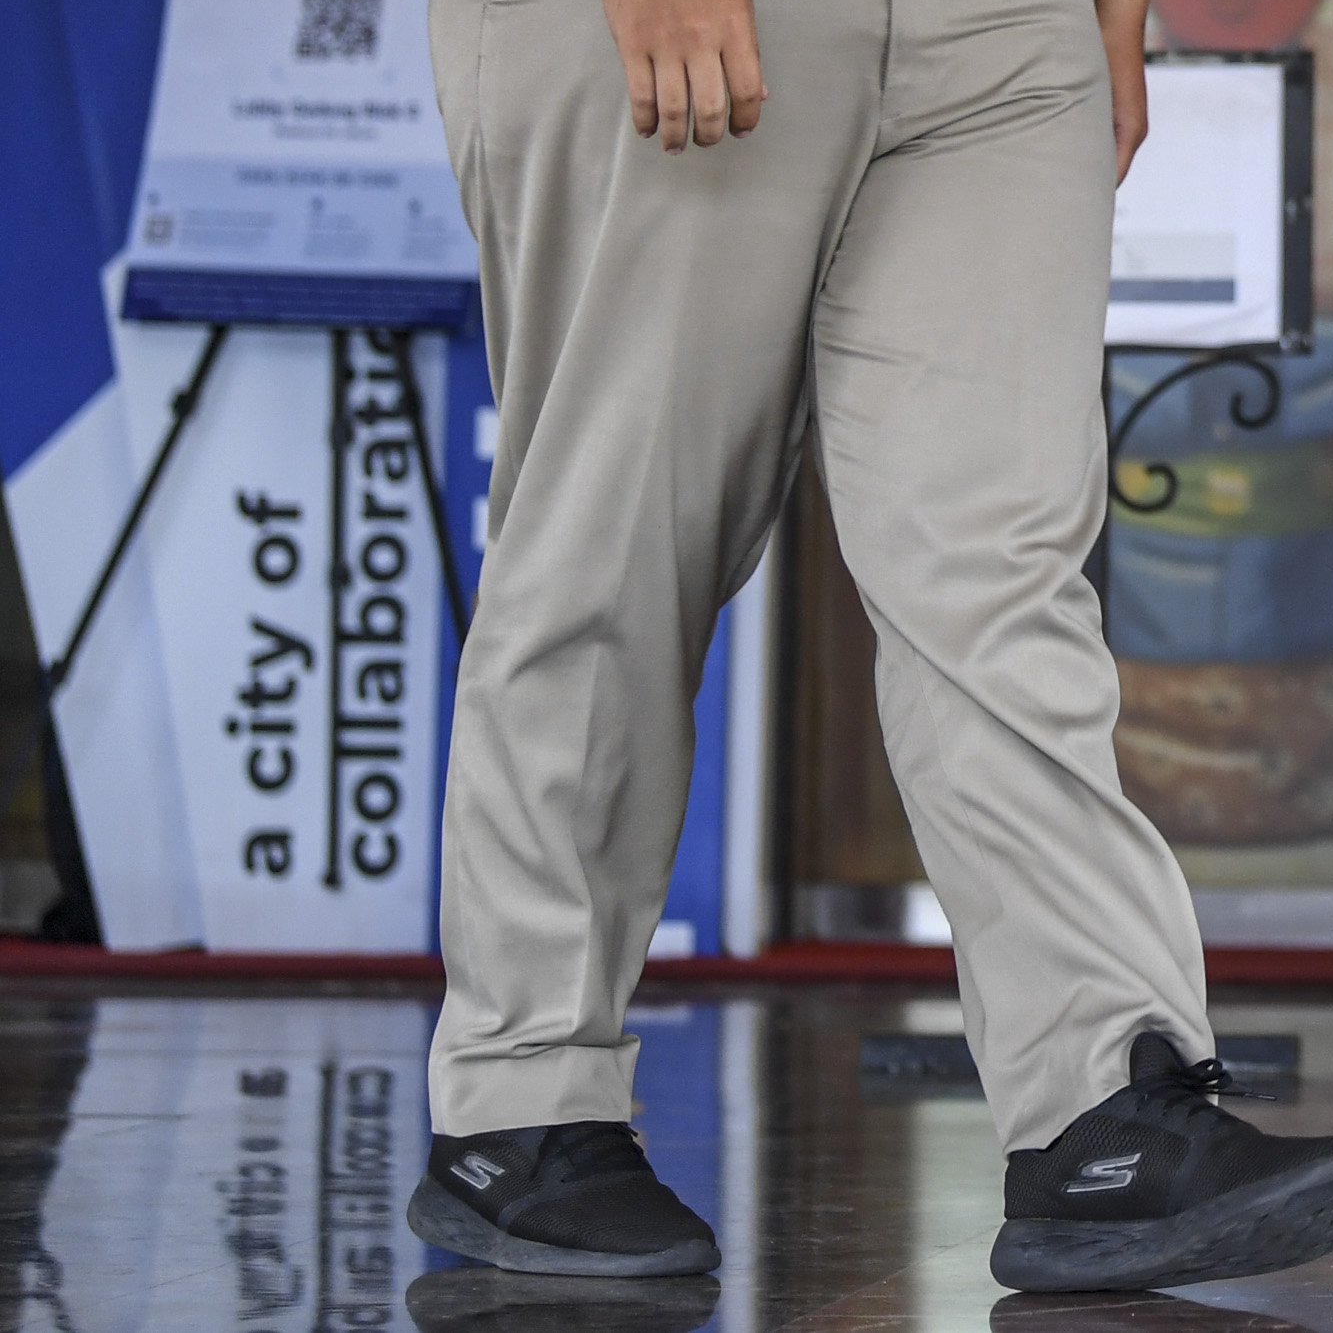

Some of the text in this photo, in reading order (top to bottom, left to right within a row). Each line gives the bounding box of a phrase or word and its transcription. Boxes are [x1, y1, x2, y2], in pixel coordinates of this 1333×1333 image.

[224, 489, 314, 876] a city of
[338, 327, 410, 877] collaborati
